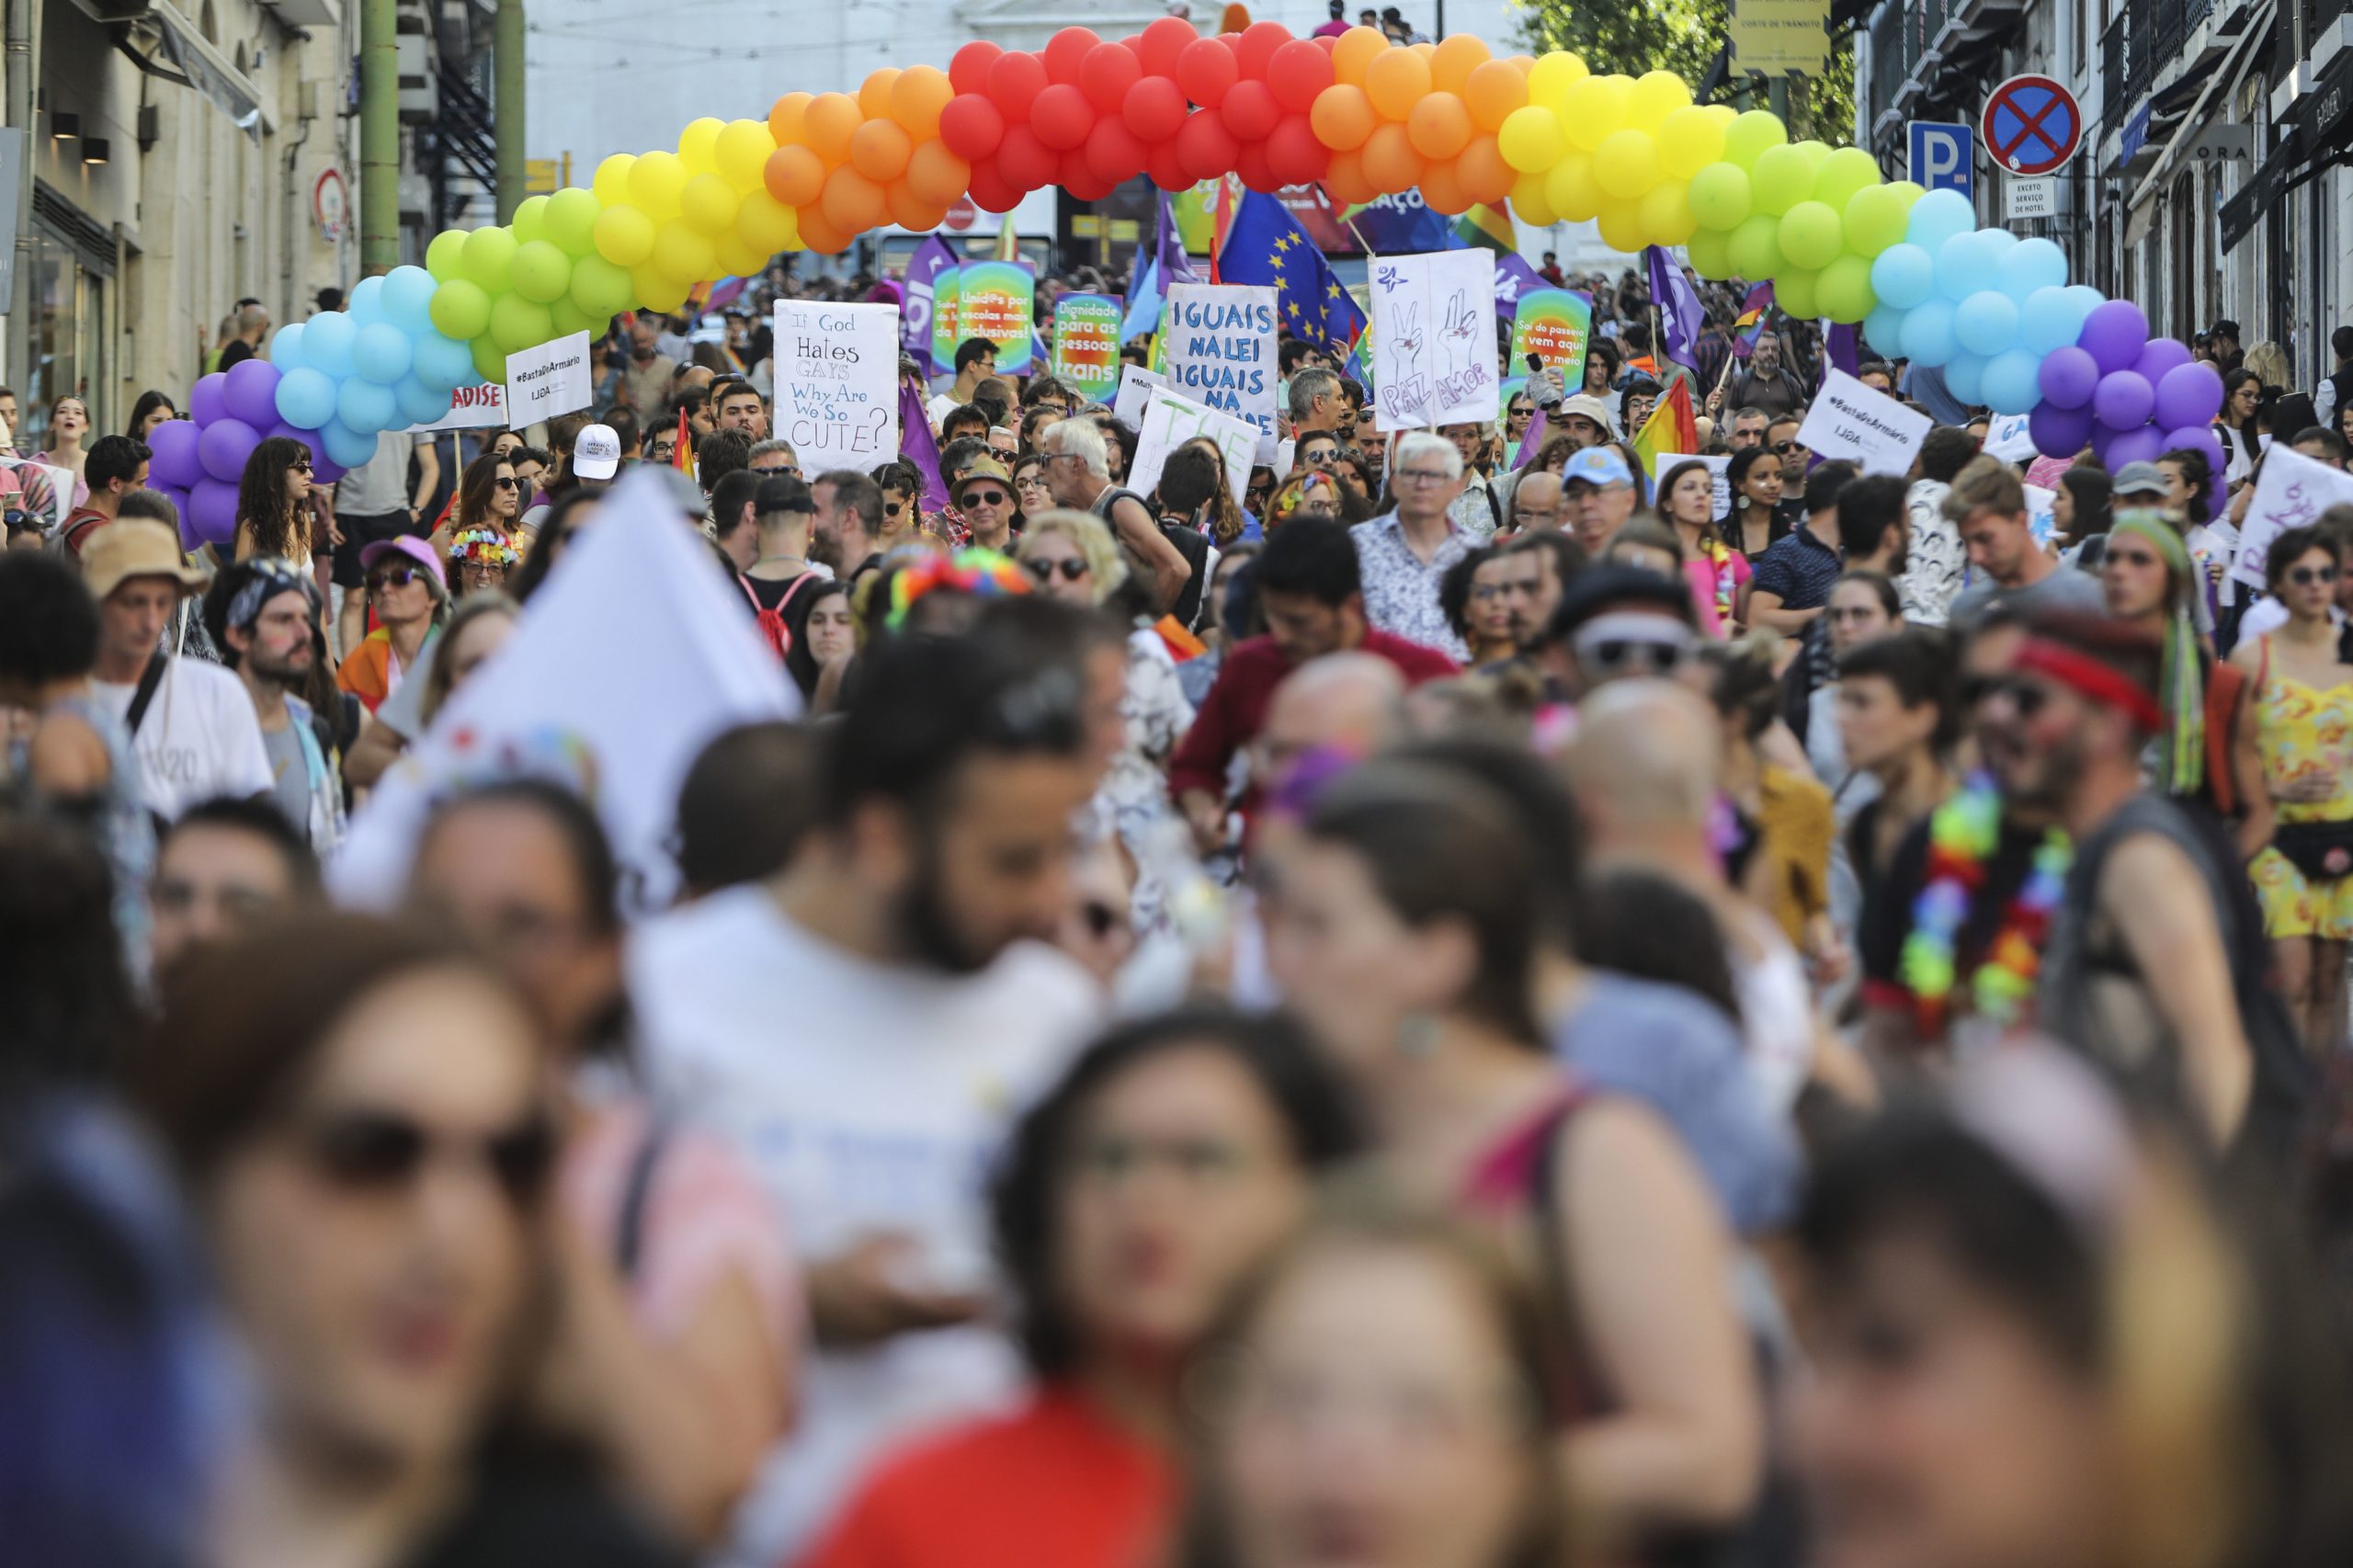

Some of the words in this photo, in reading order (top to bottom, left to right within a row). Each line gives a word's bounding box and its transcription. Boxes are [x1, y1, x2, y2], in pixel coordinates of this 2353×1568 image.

[1924, 131, 1959, 192] P
[2017, 183, 2042, 192] EXCETO
[2016, 195, 2043, 203] SERVIÇO
[2024, 204, 2045, 212] HOTEL
[961, 291, 1005, 305] Unid@s
[1007, 296, 1029, 309] por
[961, 309, 1001, 321] escolas
[1003, 310, 1029, 322] mais
[1059, 301, 1118, 320] Dignidade
[1174, 301, 1274, 334] IGUAIS
[790, 313, 808, 330] If
[818, 313, 856, 332] God
[960, 323, 1029, 339] inclusivas!
[1057, 321, 1094, 337] para
[1099, 322, 1117, 335] as
[1518, 320, 1533, 331] Sai
[1535, 323, 1547, 333] do
[1549, 326, 1585, 336] passeio
[797, 336, 859, 363] Hates
[1057, 338, 1116, 353] pessoas
[1517, 335, 1524, 344] e
[1529, 336, 1554, 347] vem
[1558, 339, 1584, 353] aqui
[516, 355, 581, 382] #BastaDeArmário
[796, 359, 850, 381] GAYS
[1055, 348, 1115, 382] trans
[1554, 355, 1581, 366] meio
[1176, 364, 1264, 395] IGUAIS
[1435, 363, 1492, 410] AMOR
[790, 382, 832, 405] Why
[835, 383, 868, 403] Are
[1204, 391, 1241, 412] NA
[1381, 372, 1432, 417] PAZ
[793, 400, 820, 419] We
[824, 404, 847, 421] So
[1830, 396, 1909, 445] #BastaDeArmário
